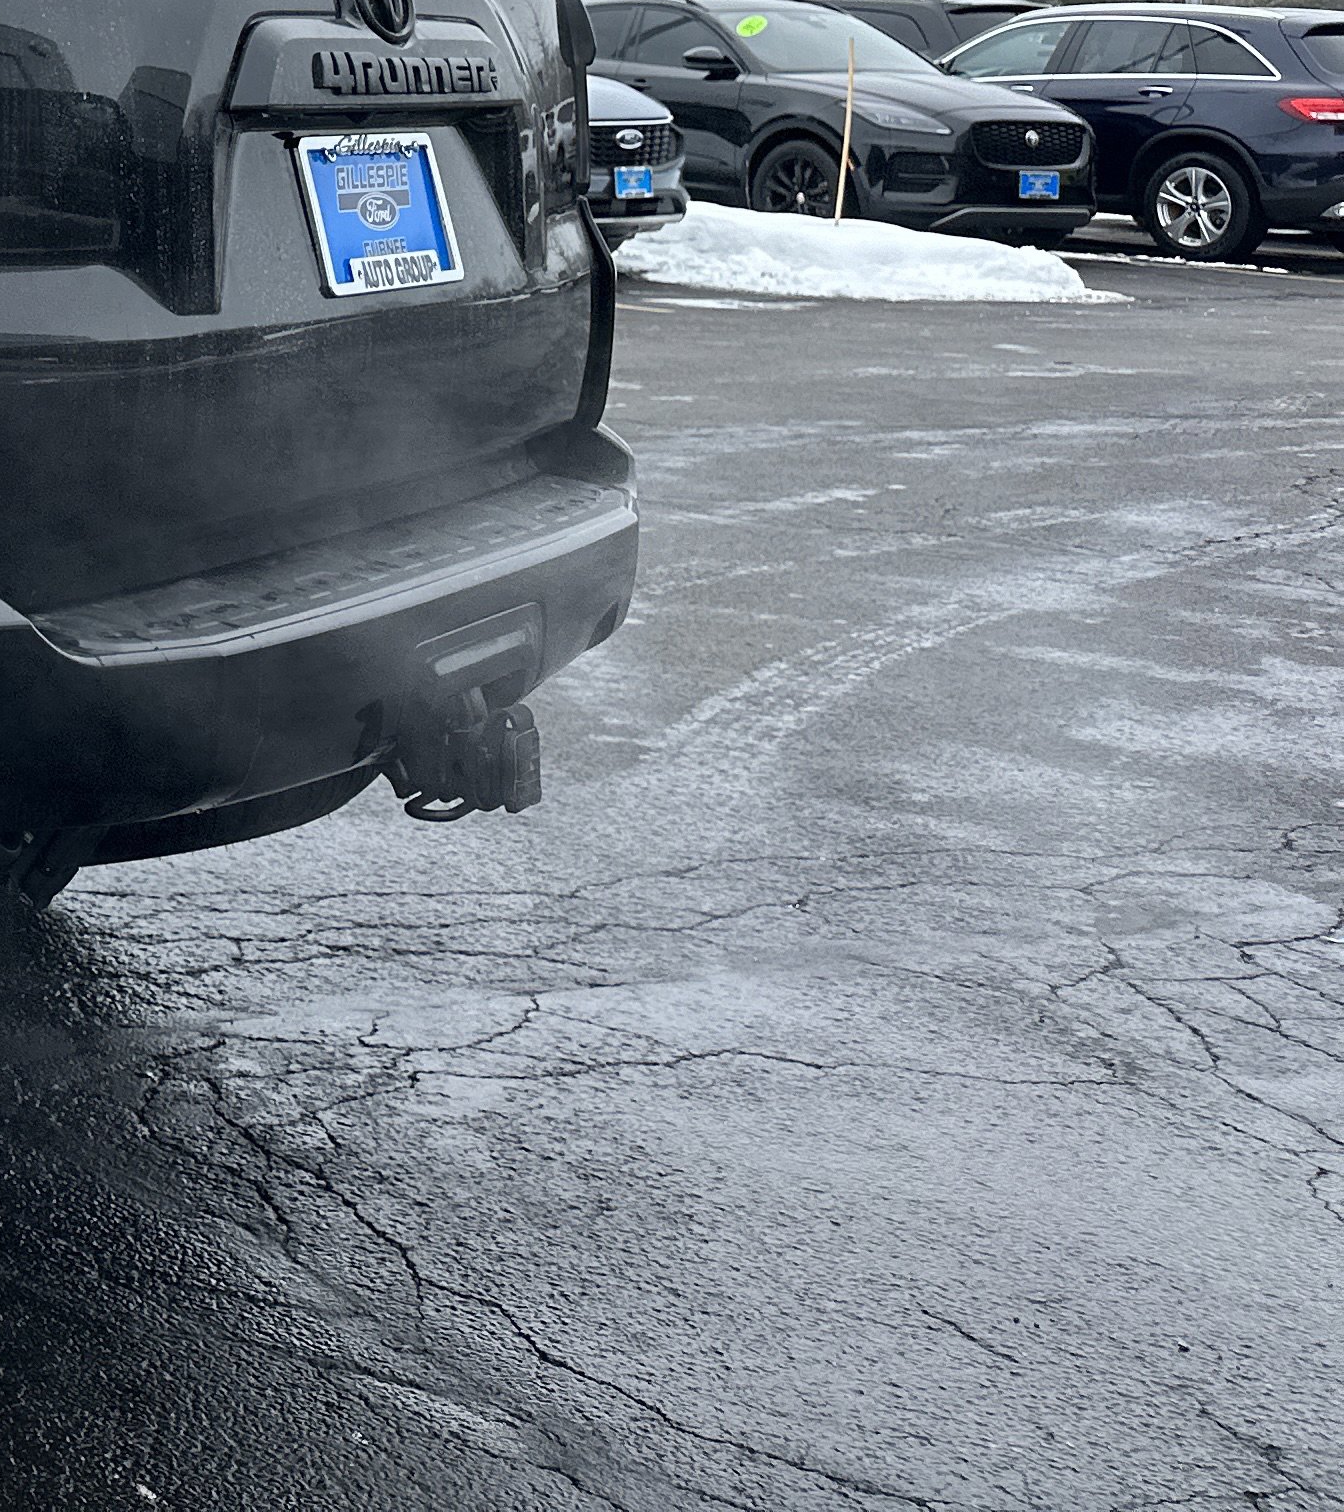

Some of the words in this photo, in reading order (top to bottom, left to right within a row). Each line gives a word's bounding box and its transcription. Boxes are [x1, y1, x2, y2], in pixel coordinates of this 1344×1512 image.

[337, 134, 402, 156] Gillespie
[335, 162, 409, 190] GILLESPIE
[366, 199, 392, 223] Ford
[362, 258, 395, 289] AUTO
[395, 254, 434, 285] GROUP
